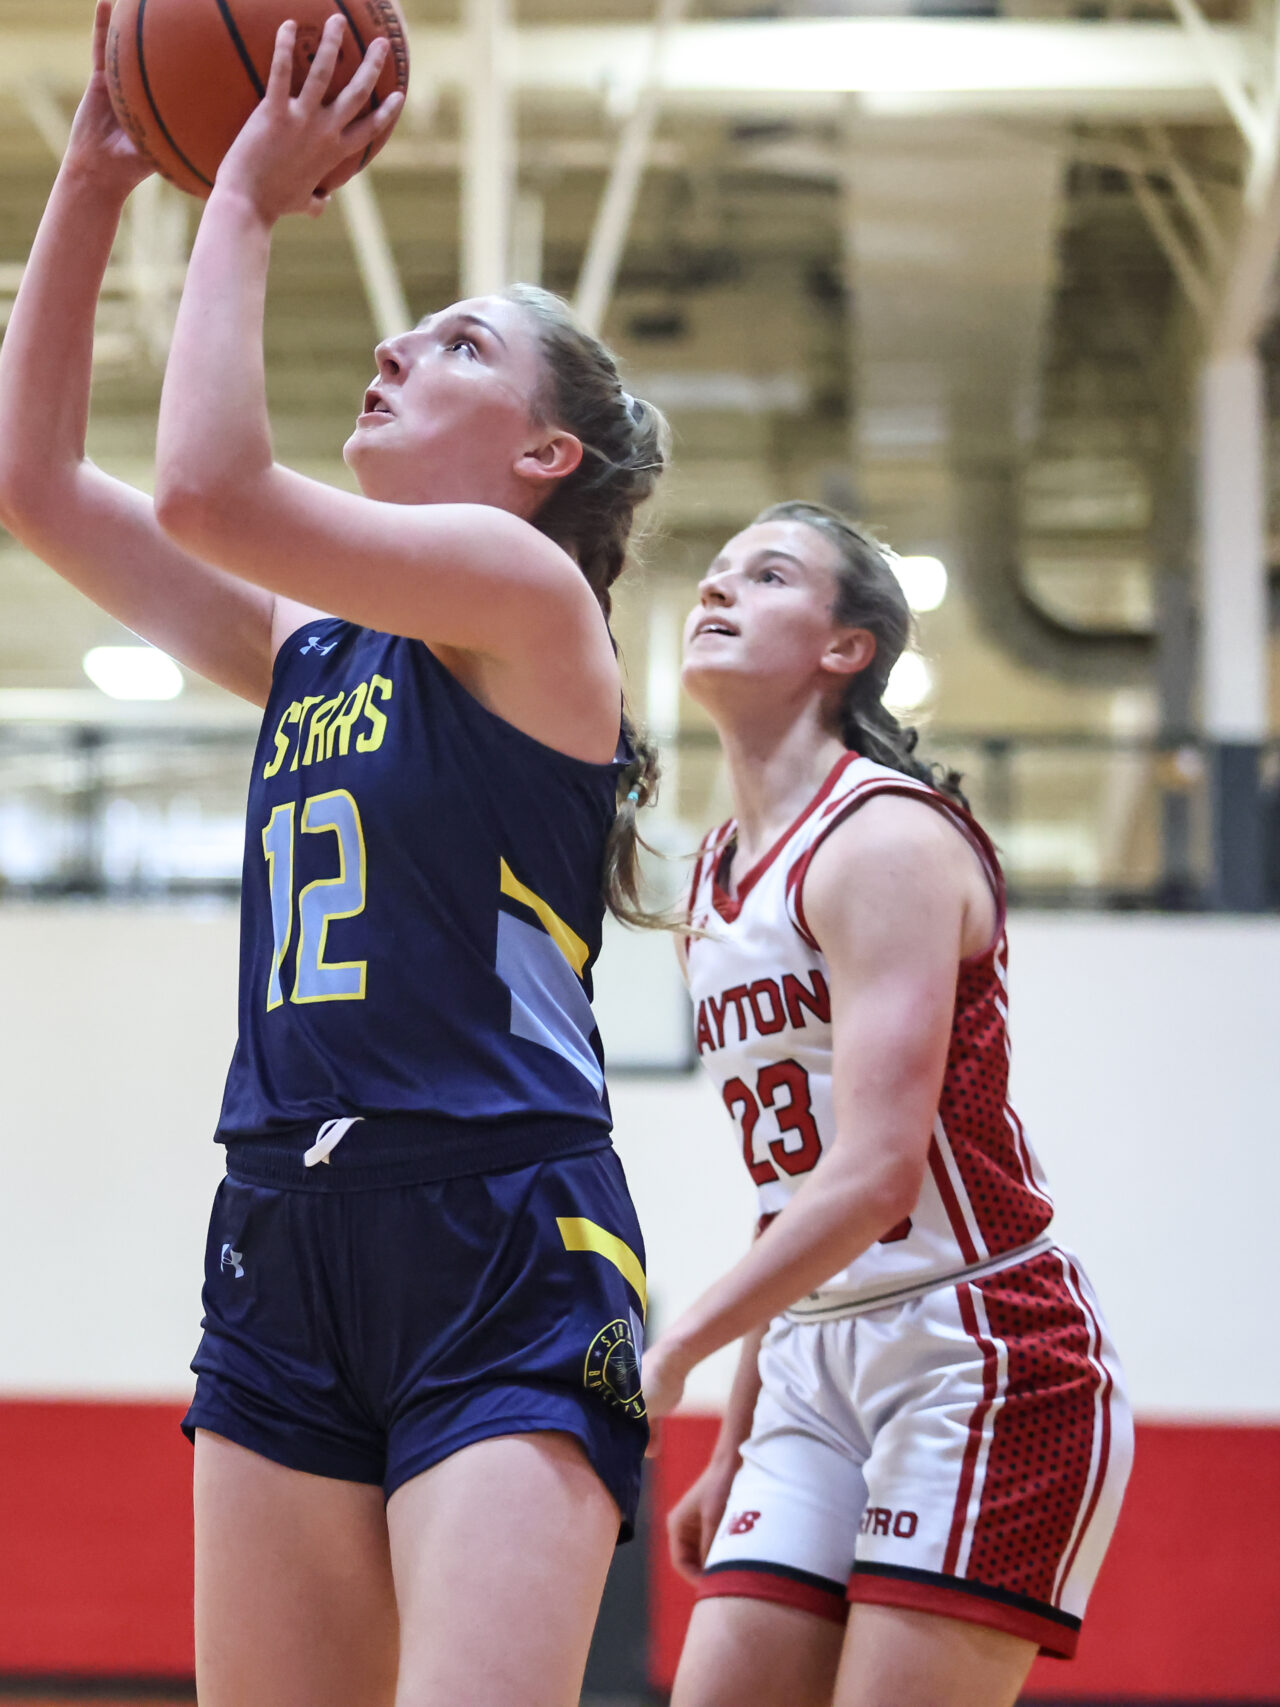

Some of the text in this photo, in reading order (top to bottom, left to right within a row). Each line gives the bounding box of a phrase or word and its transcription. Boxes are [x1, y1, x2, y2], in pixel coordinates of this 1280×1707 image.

[263, 673, 393, 780] STARS
[261, 788, 368, 1013] 12
[721, 1057, 823, 1187] 23
[858, 1506, 919, 1539] TRO
